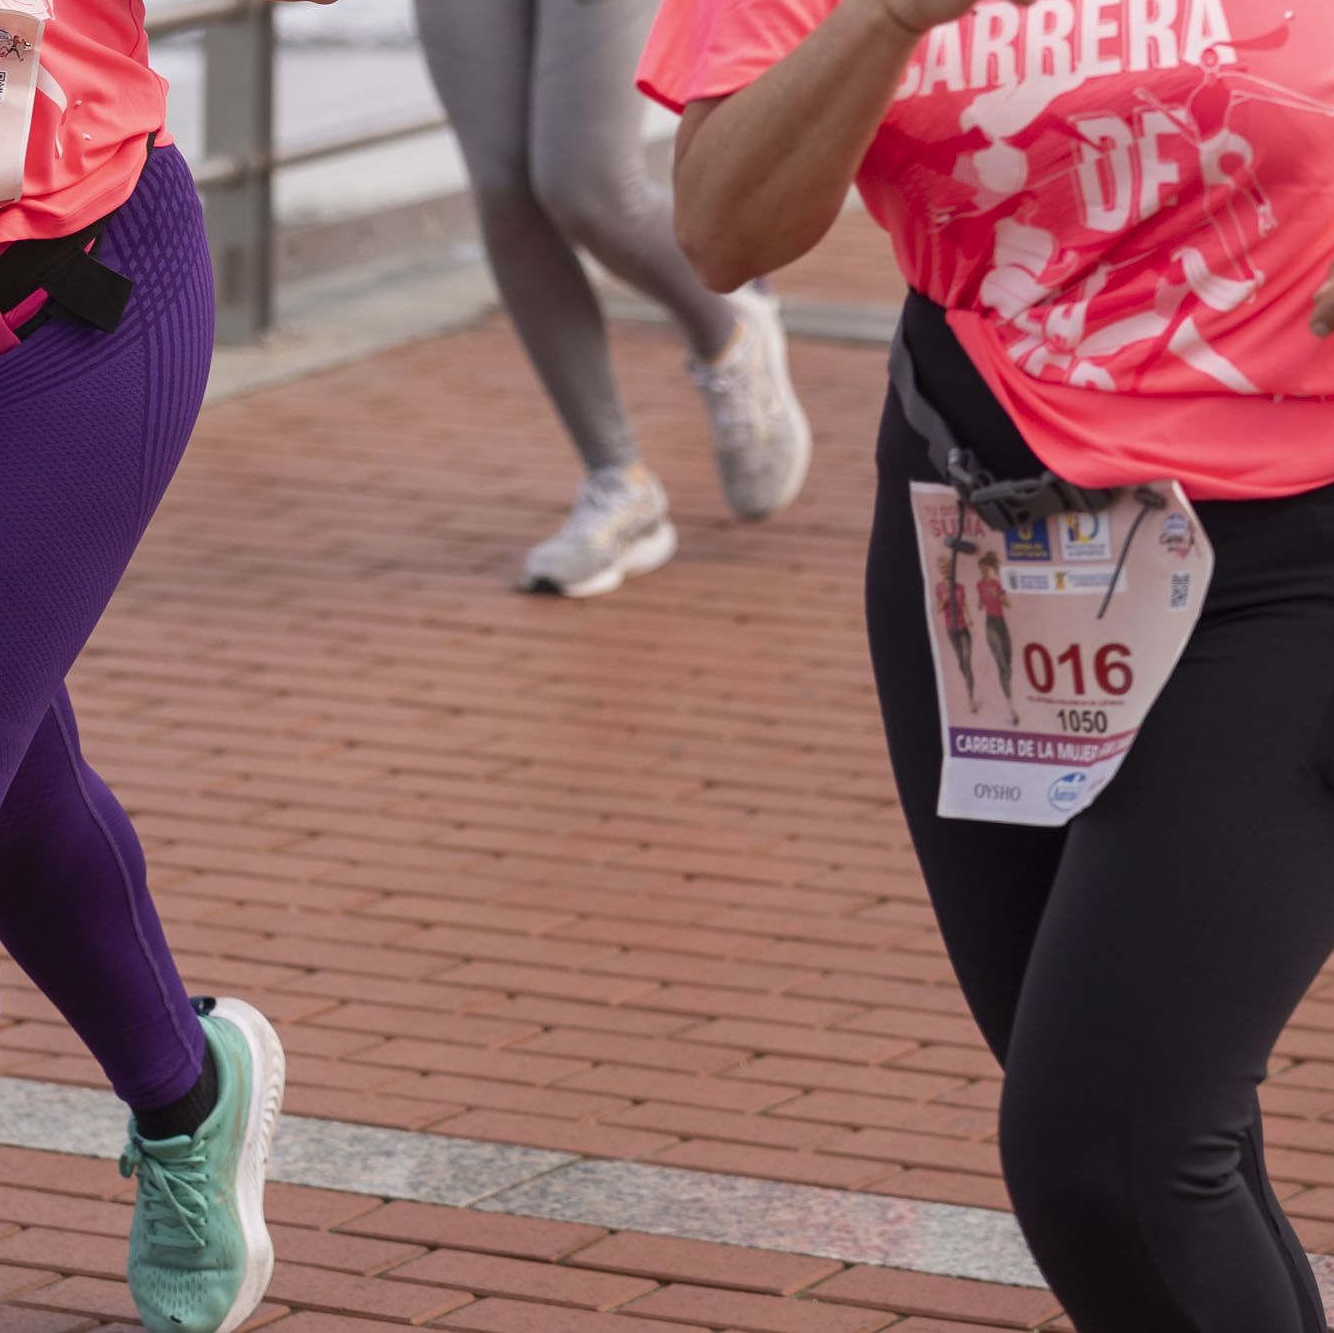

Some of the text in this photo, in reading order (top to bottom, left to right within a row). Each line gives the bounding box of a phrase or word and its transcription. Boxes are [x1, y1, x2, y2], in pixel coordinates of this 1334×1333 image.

[1022, 641, 1134, 697] 016
[1056, 708, 1108, 734] 1050
[955, 734, 1014, 756] CARRERA
[1017, 740, 1034, 758] DE
[1037, 741, 1052, 759] LA
[973, 782, 1022, 802] OYSHO
